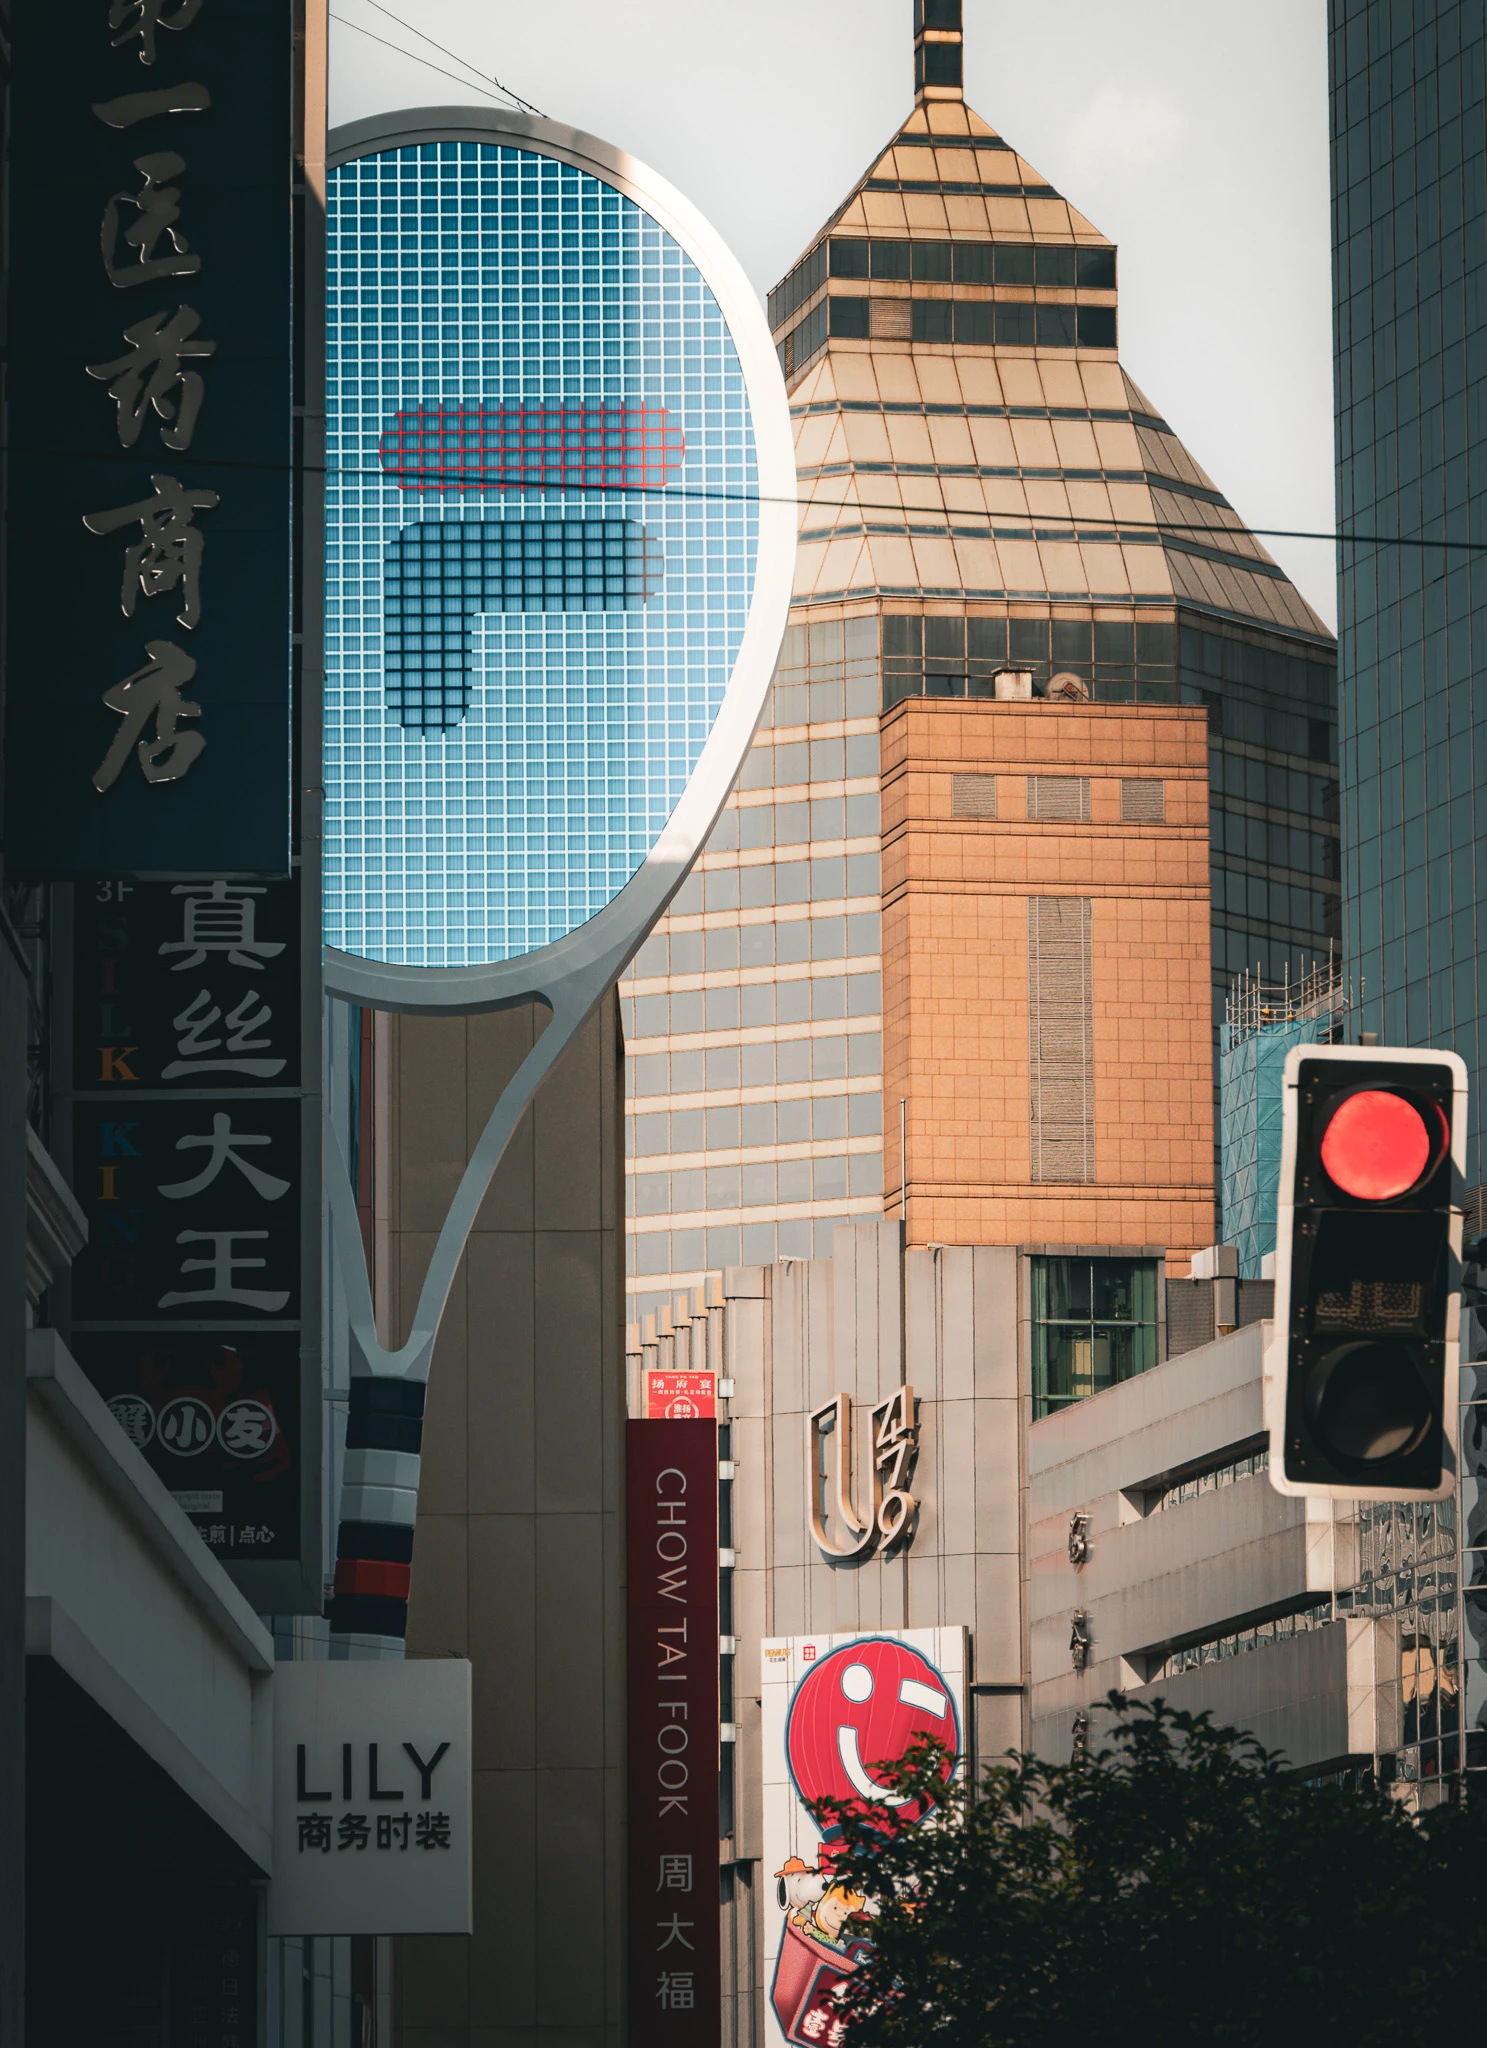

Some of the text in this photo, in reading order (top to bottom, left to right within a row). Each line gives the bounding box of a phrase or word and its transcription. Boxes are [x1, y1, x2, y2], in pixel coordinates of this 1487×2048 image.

[157, 881, 292, 1313] 真丝大王
[656, 1467, 689, 1818] CHOW TAI FOOK
[296, 1811, 451, 1854] 商务时装
[297, 1742, 451, 1801] LILY
[655, 1853, 696, 2010] 周大福
